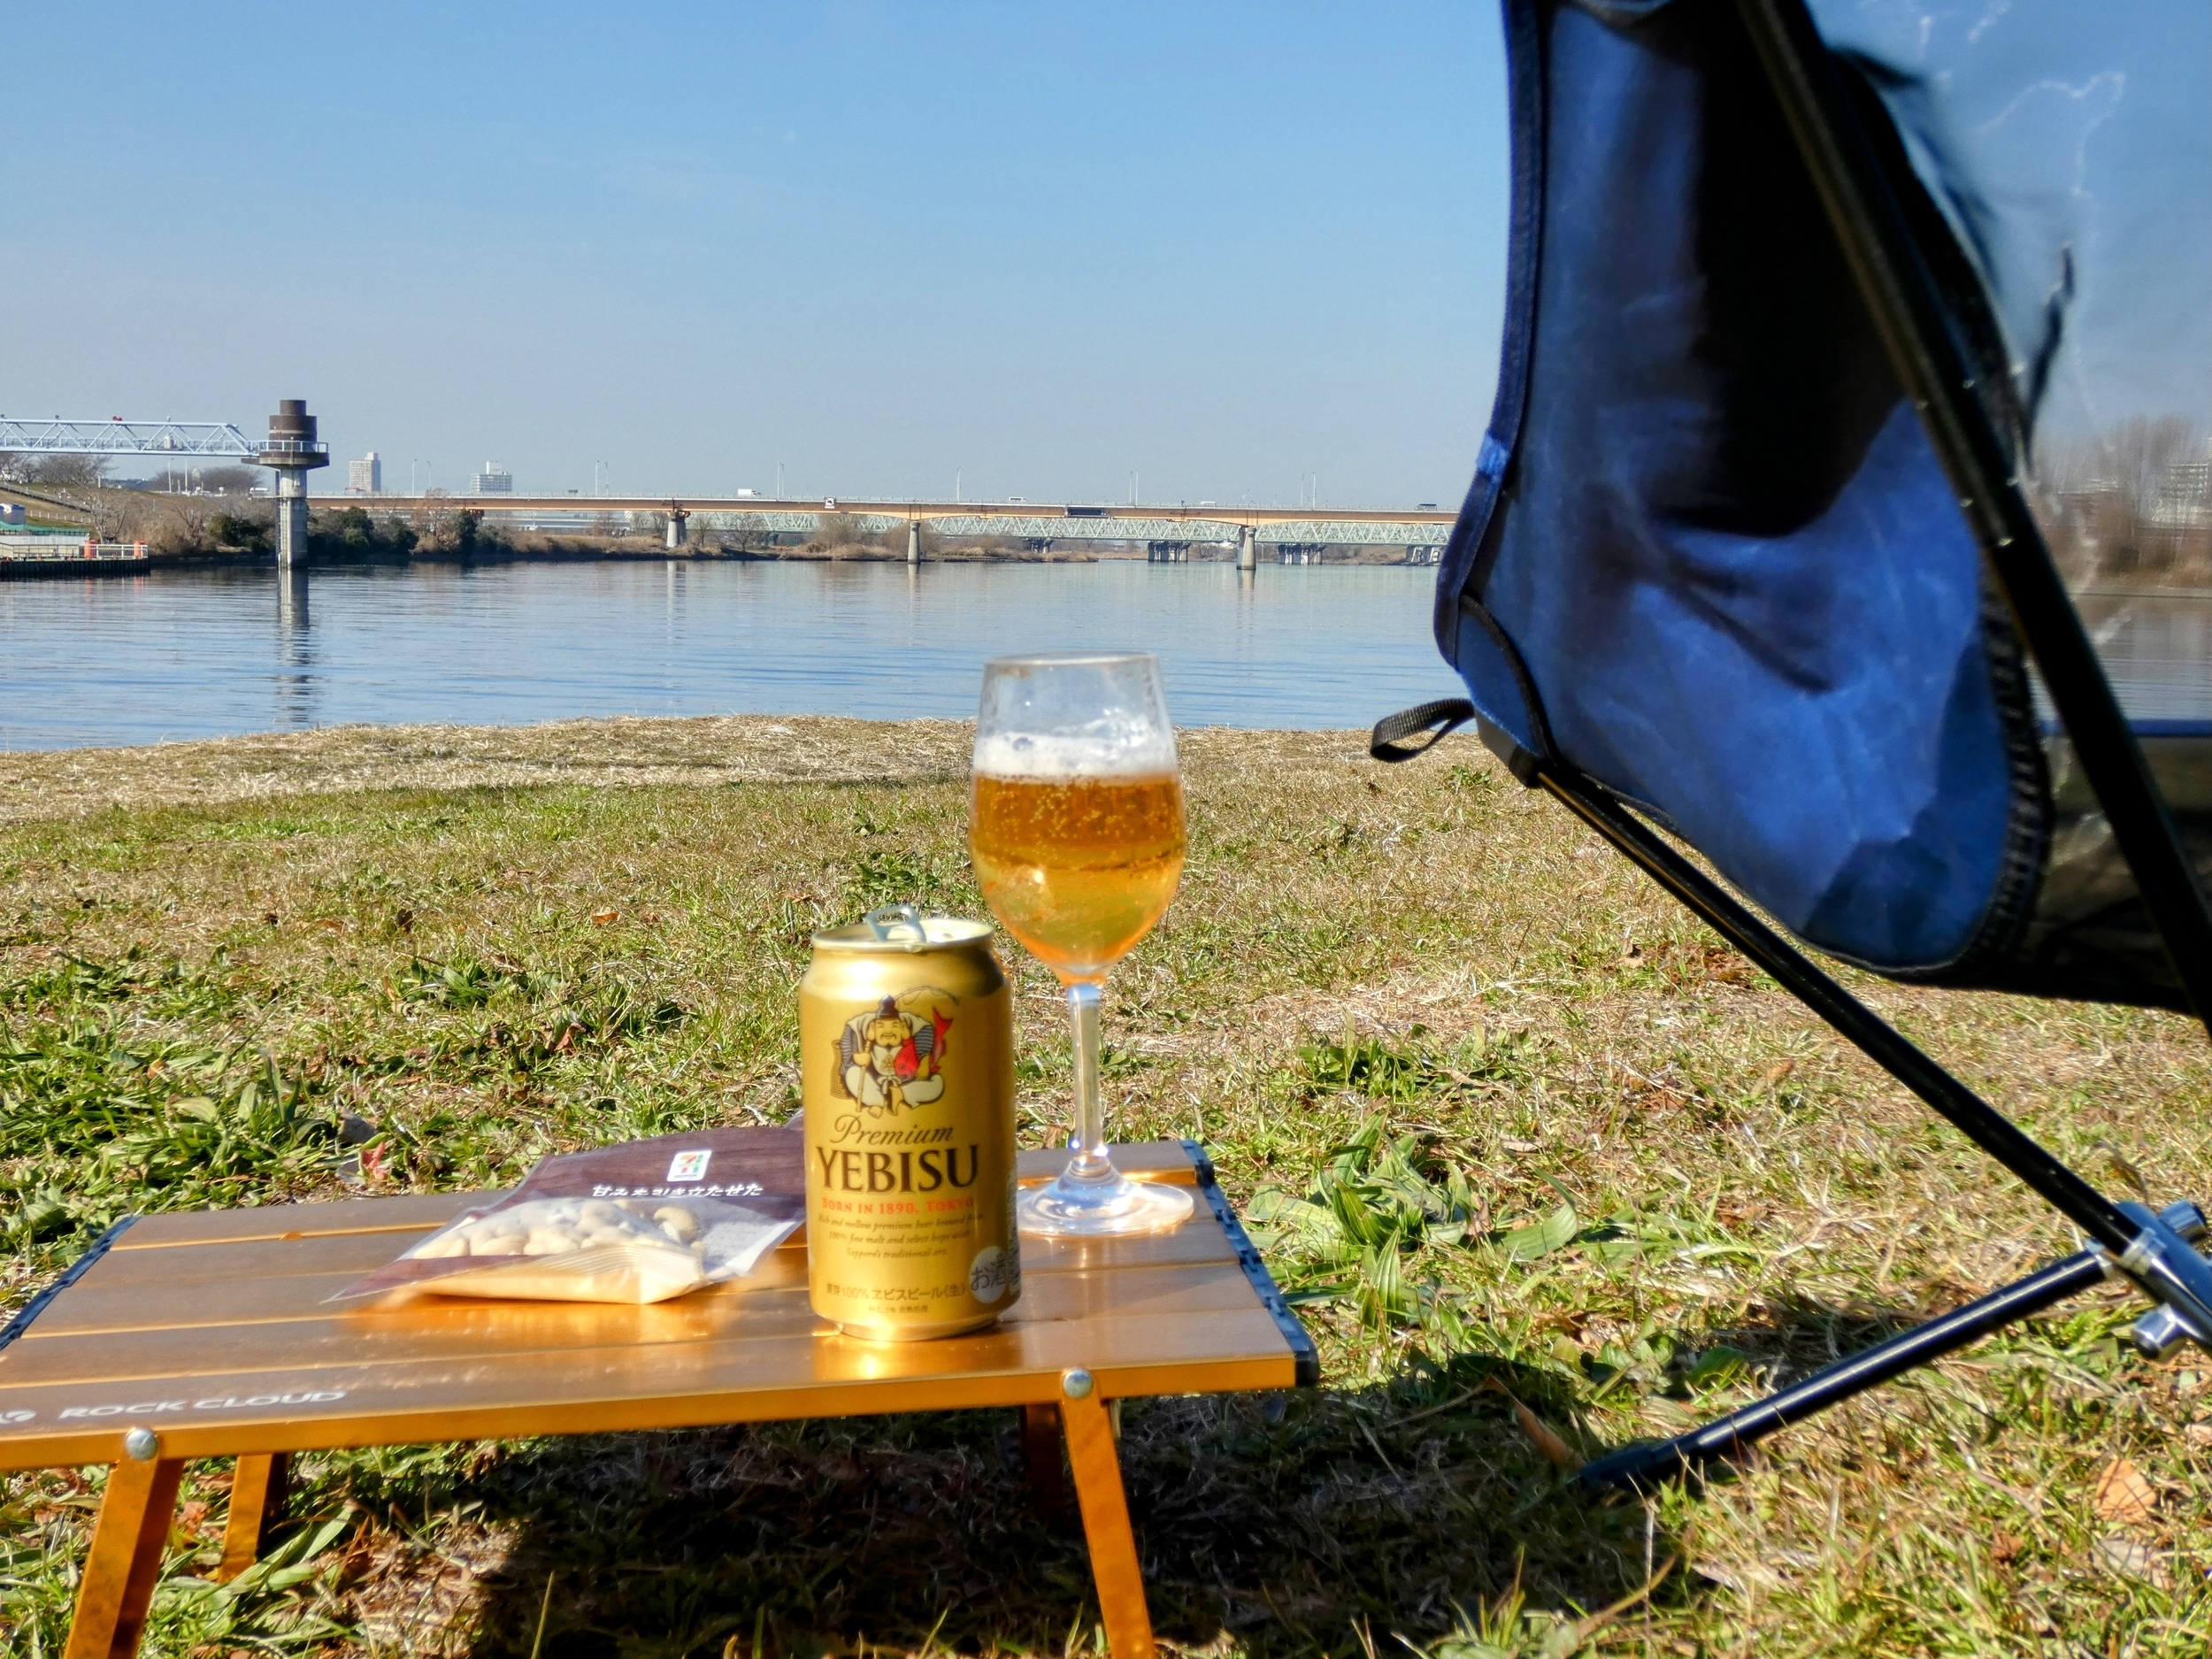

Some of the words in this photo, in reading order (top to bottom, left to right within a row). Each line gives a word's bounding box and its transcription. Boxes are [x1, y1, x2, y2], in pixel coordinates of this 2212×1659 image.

[830, 1115, 954, 1145] Premium
[815, 1144, 979, 1194] YEBISU
[822, 1197, 852, 1212] BORN
[857, 1203, 873, 1214] IN
[879, 1202, 918, 1216] 1890,
[926, 1196, 973, 1213] TOKYO
[844, 1219, 872, 1229] mellow
[872, 1223, 912, 1233] premium
[866, 1235, 885, 1244] malt
[887, 1235, 905, 1244] and
[883, 1248, 932, 1258] traditional
[971, 1252, 1006, 1291] お酒
[58, 1400, 188, 1419] ROCK
[193, 1390, 347, 1410] CLOUD
